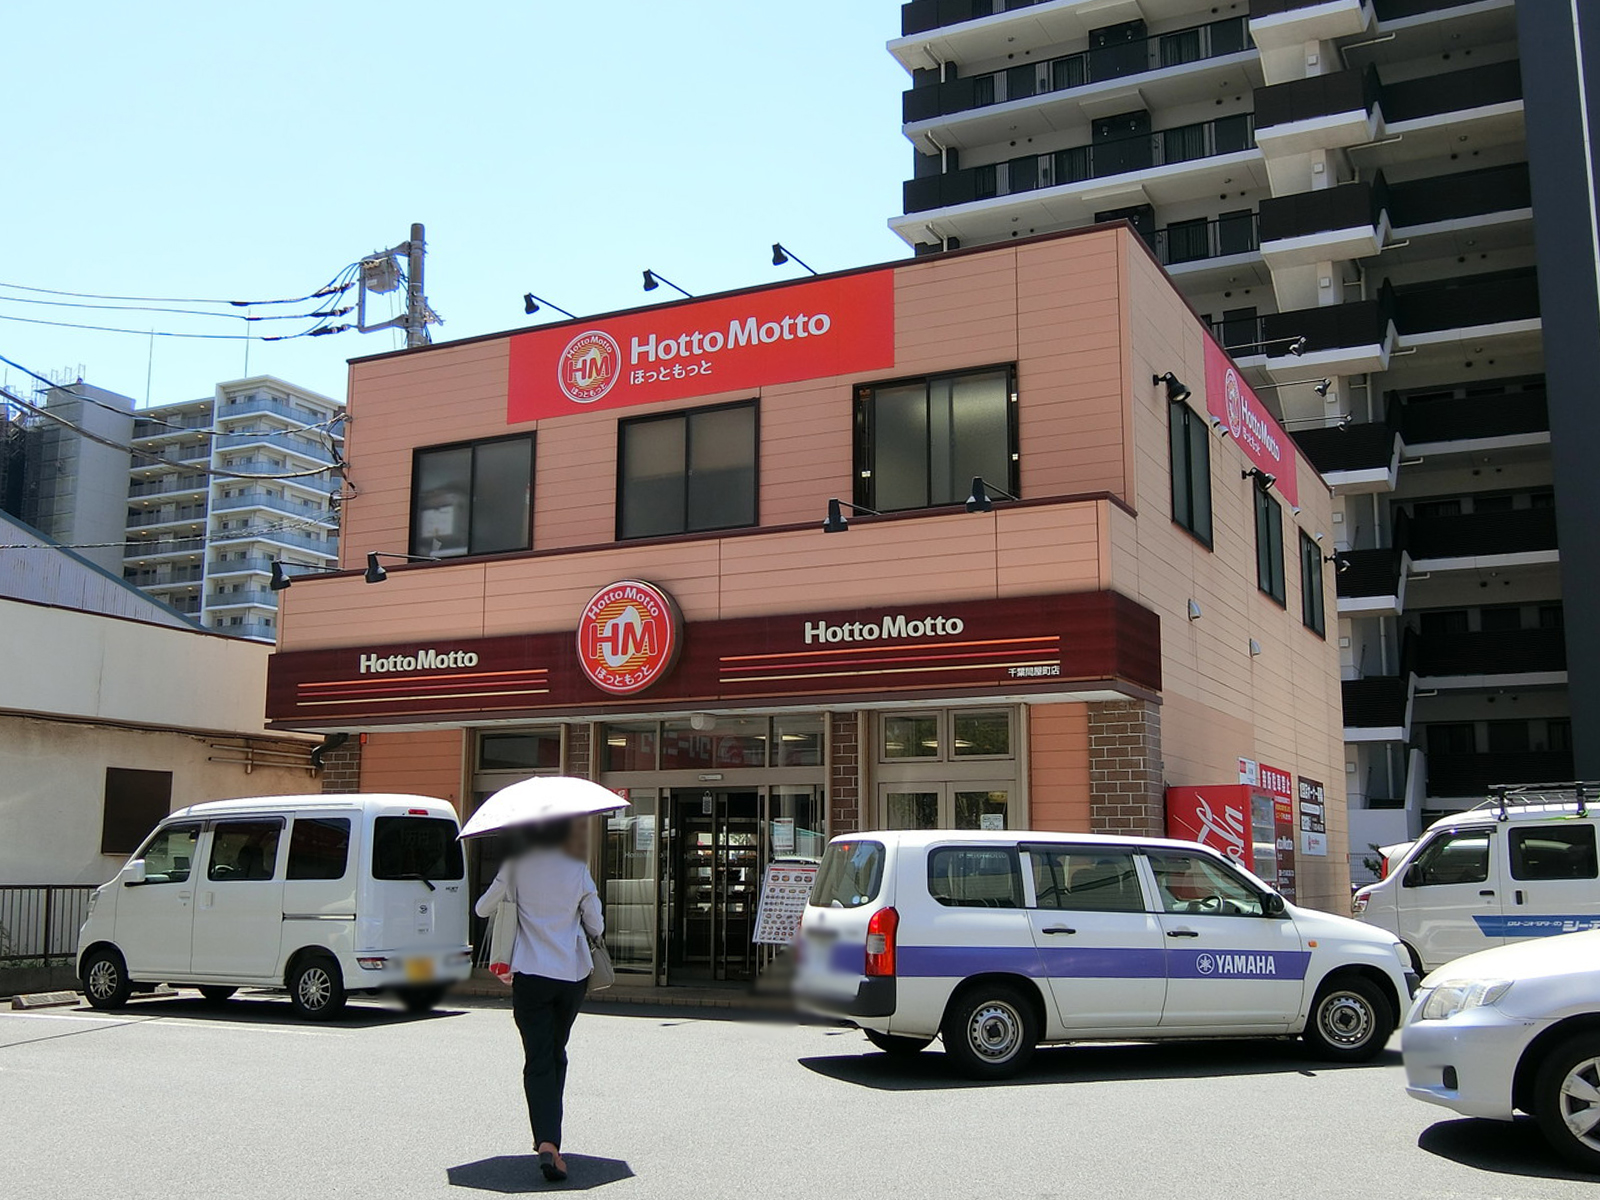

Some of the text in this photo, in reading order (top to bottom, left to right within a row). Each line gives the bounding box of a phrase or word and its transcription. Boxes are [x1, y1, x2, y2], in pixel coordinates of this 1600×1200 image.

[566, 335, 612, 359] HottoMotto
[630, 312, 831, 365] HottoMotto
[630, 360, 713, 385] ほっともっと
[571, 382, 607, 398] ほっともっと
[1241, 396, 1280, 462] HottoMotto
[588, 587, 660, 620] HottoMotto
[804, 614, 964, 645] HottoMotto
[359, 648, 479, 674] HottoMotto
[595, 664, 652, 686] ほっともっと
[1215, 954, 1277, 975] YAMAHA
